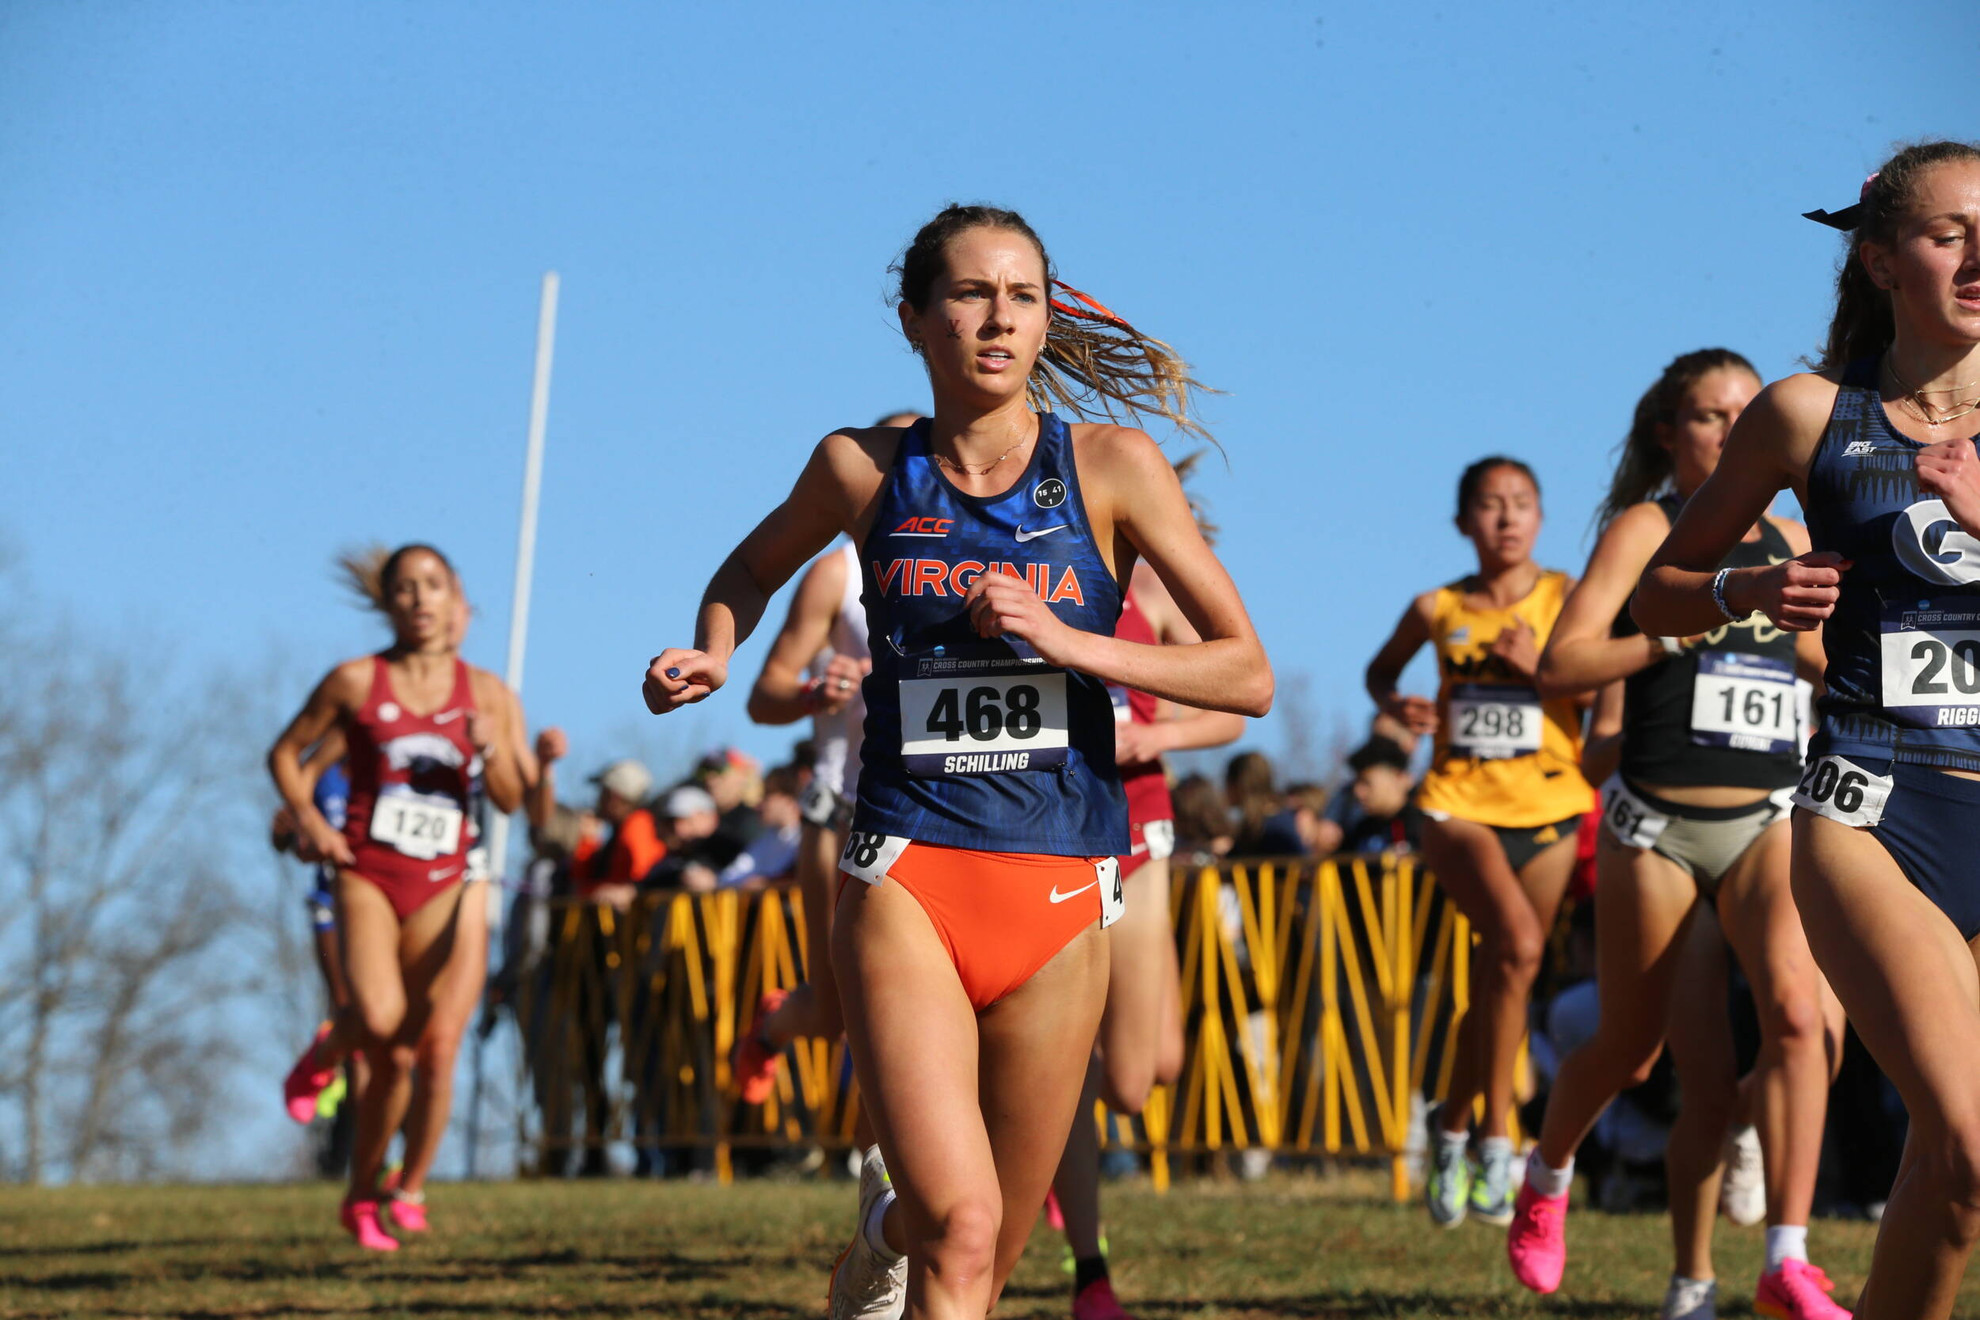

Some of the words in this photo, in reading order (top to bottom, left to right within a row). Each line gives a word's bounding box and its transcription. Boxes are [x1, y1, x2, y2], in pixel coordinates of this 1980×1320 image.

[1038, 489, 1048, 497] 15
[1052, 485, 1062, 493] 41
[894, 516, 955, 533] ACC
[1918, 613, 1942, 621] CROSS
[1943, 613, 1976, 621] COUNTRY
[933, 660, 957, 669] CROSS
[958, 659, 989, 668] COUNTRY
[926, 685, 1042, 742] 468
[1719, 686, 1783, 728] 161
[1462, 706, 1523, 738] 298
[944, 752, 1030, 774] SCHILLING
[1797, 760, 1869, 813] 206
[394, 810, 446, 839] 120
[1113, 865, 1123, 905] 4
